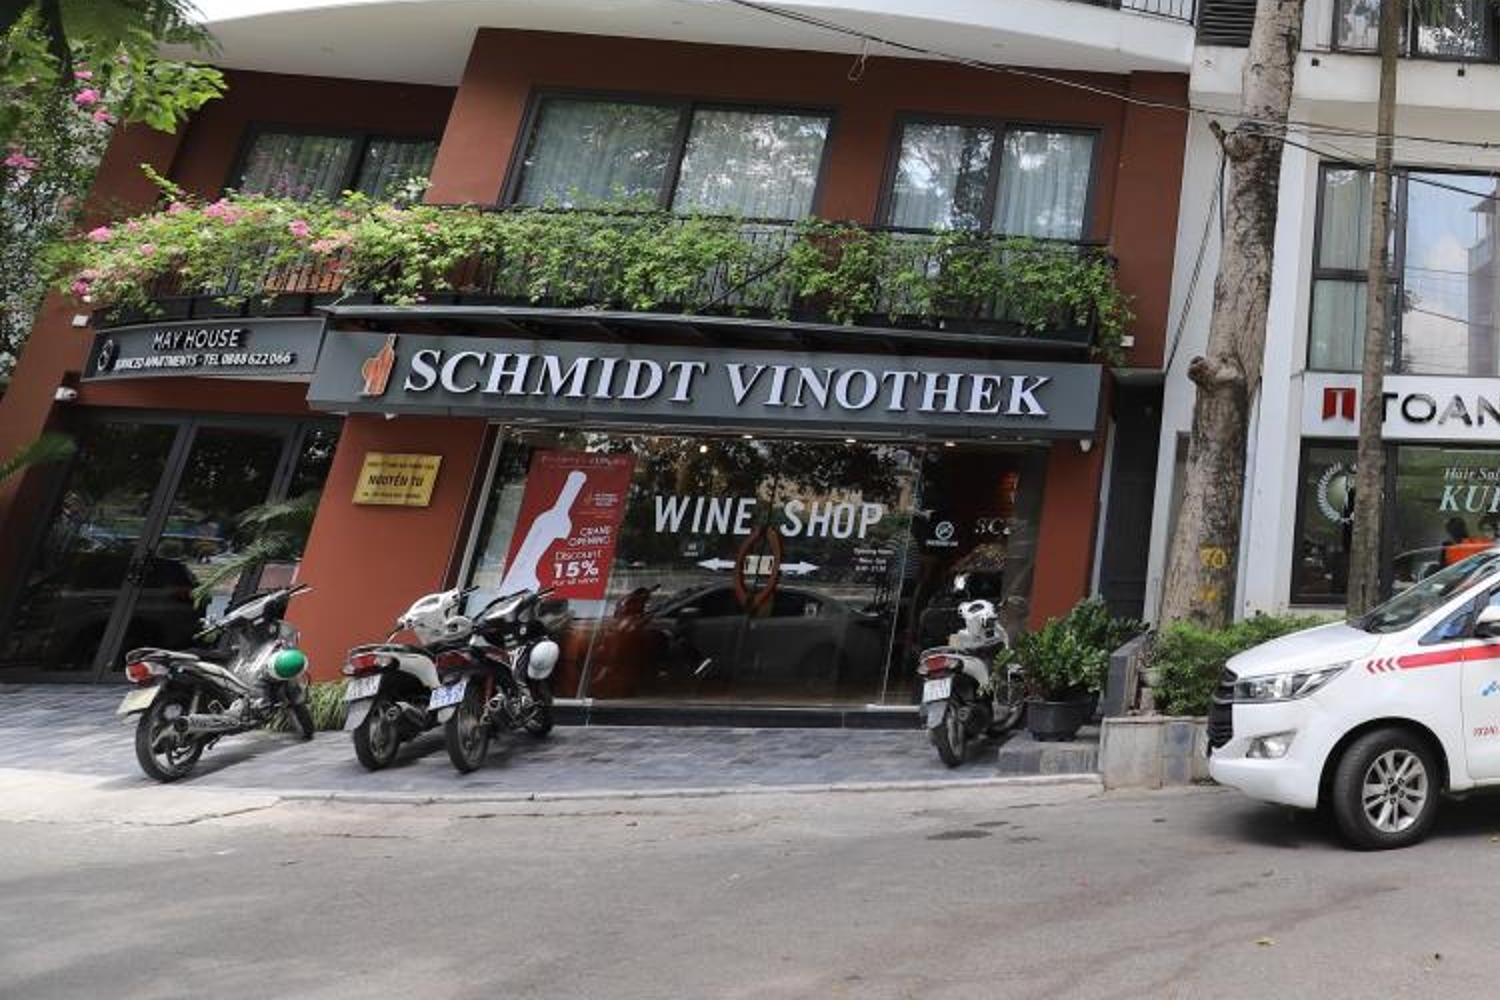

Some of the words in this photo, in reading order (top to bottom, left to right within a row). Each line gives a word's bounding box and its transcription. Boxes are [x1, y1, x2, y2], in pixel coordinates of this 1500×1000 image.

[153, 331, 180, 350] MAY
[184, 329, 241, 348] HOUSE
[403, 349, 706, 402] SCHMIDT
[726, 363, 1050, 415] VINOTHEK
[1443, 466, 1477, 481] Hair
[655, 495, 757, 535] WINE
[780, 499, 884, 539] SHOP
[553, 560, 599, 579] 15%
